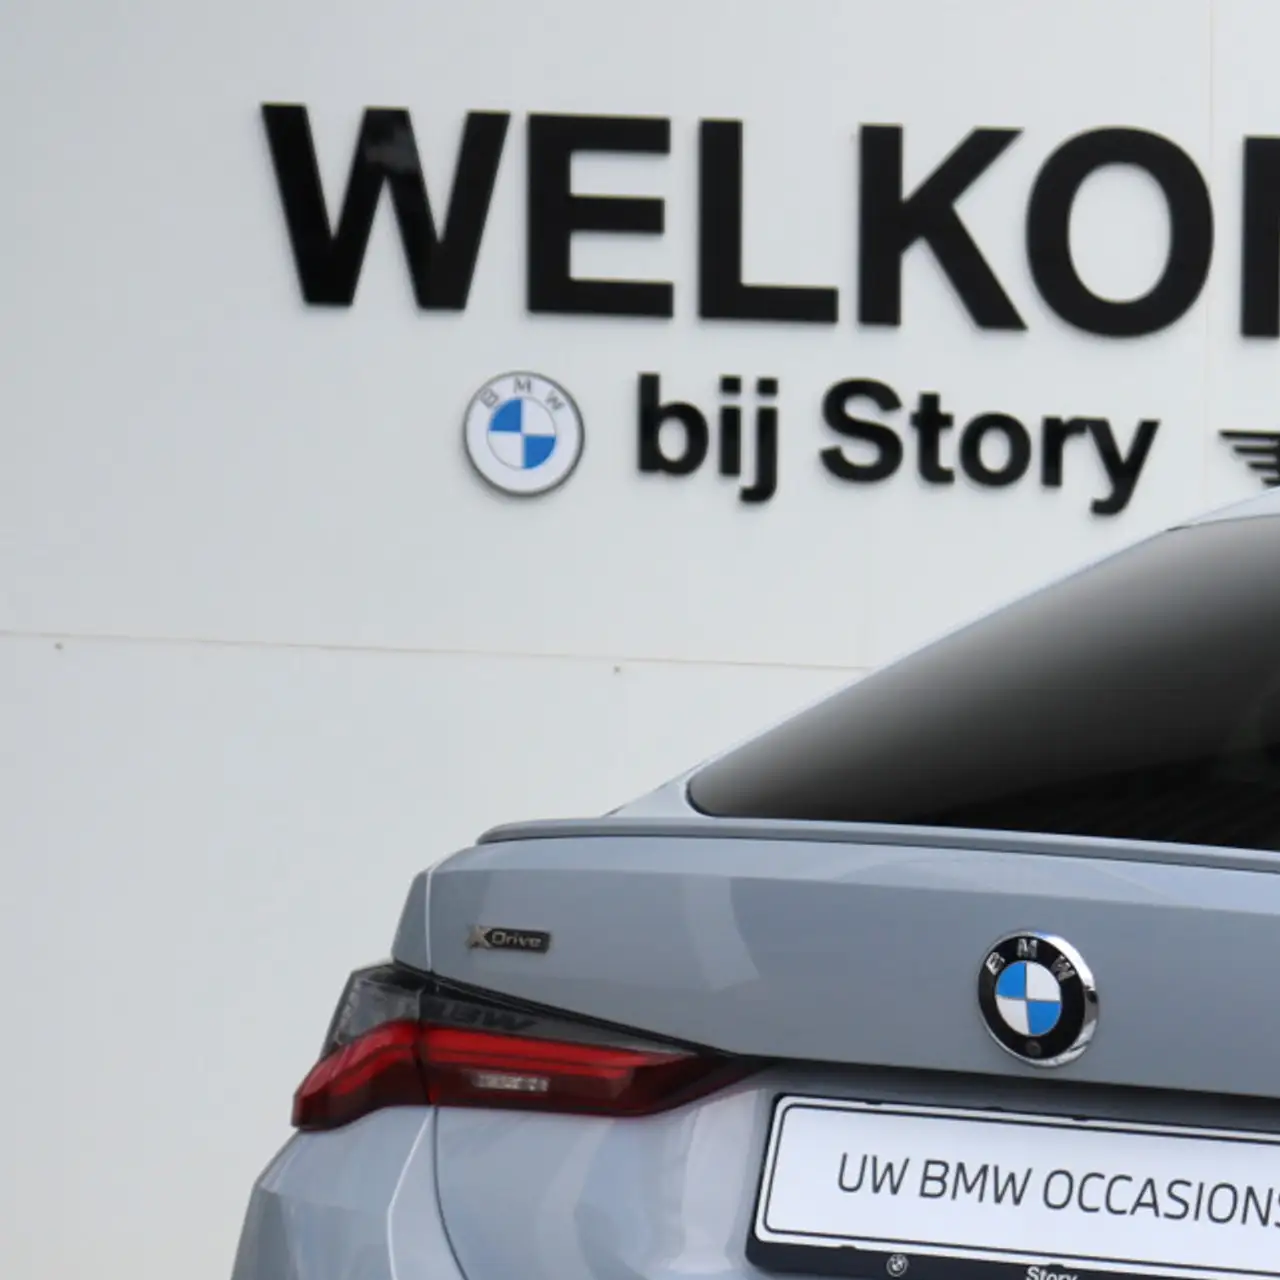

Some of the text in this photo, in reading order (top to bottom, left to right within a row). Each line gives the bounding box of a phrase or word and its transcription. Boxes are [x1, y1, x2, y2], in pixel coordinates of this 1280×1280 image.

[637, 372, 1162, 518] bij Story
[984, 938, 1077, 982] BMW
[837, 1151, 911, 1196] UW
[918, 1158, 1033, 1207] BMW
